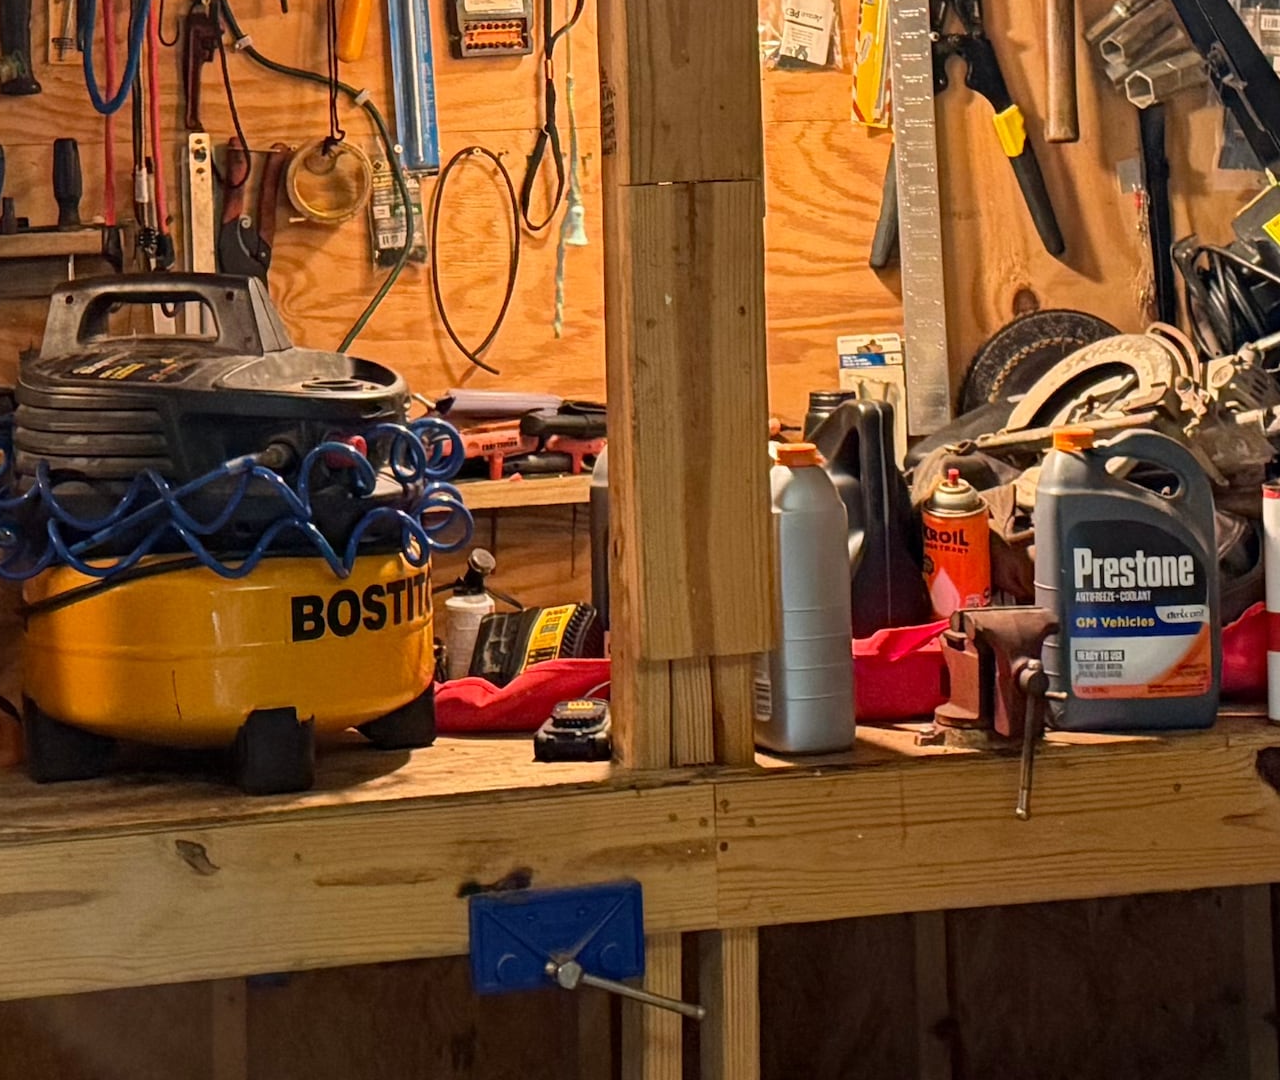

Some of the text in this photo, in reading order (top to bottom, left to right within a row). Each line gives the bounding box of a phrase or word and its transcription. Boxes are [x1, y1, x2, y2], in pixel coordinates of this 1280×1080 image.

[1073, 547, 1195, 590] Prestone
[1076, 616, 1156, 629] GM Vehicles
